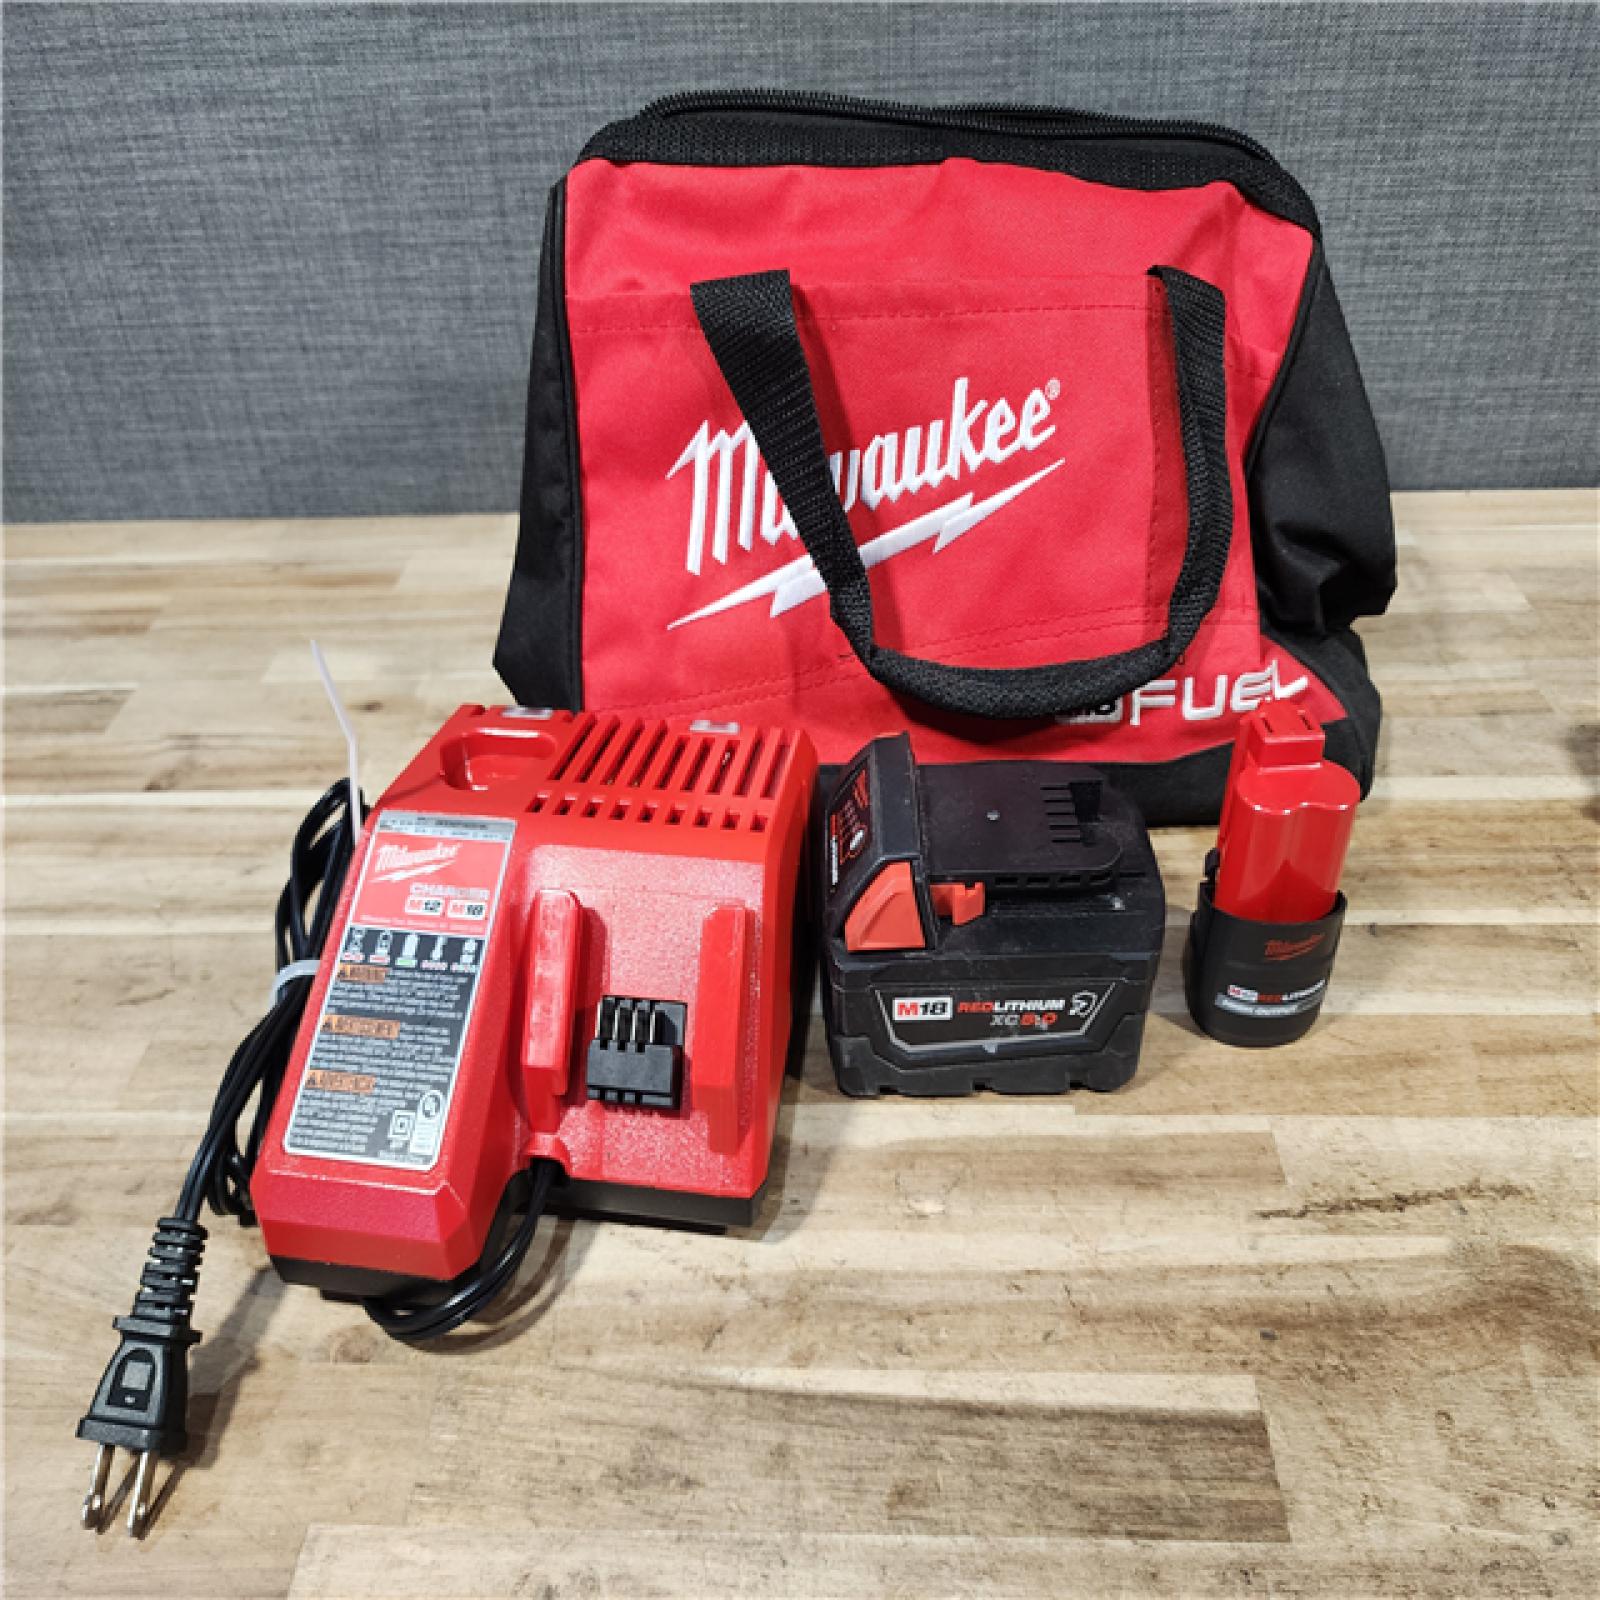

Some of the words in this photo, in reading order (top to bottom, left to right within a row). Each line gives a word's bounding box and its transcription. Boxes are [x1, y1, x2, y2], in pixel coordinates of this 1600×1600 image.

[666, 377, 1057, 576] Miwaukee
[1130, 660, 1309, 726] FUEL
[897, 1000, 948, 1017] M18
[957, 999, 1066, 1013] REDLITHIUM
